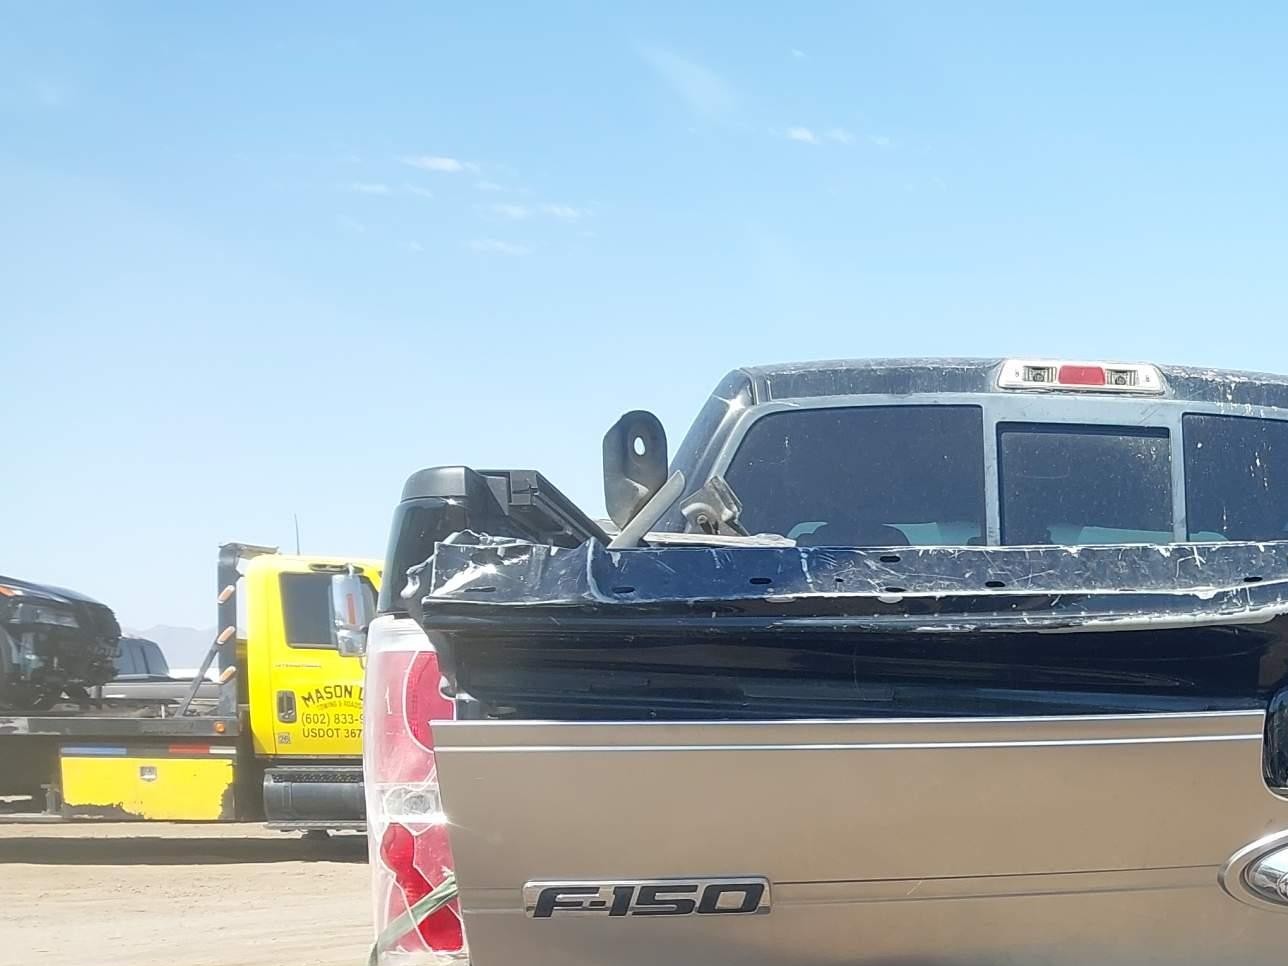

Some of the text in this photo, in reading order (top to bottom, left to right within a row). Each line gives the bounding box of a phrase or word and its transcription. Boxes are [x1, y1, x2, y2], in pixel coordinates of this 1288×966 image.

[301, 685, 353, 708] MASON
[301, 712, 330, 727] (602)
[302, 728, 341, 738] USDOT
[533, 883, 765, 918] F-150
